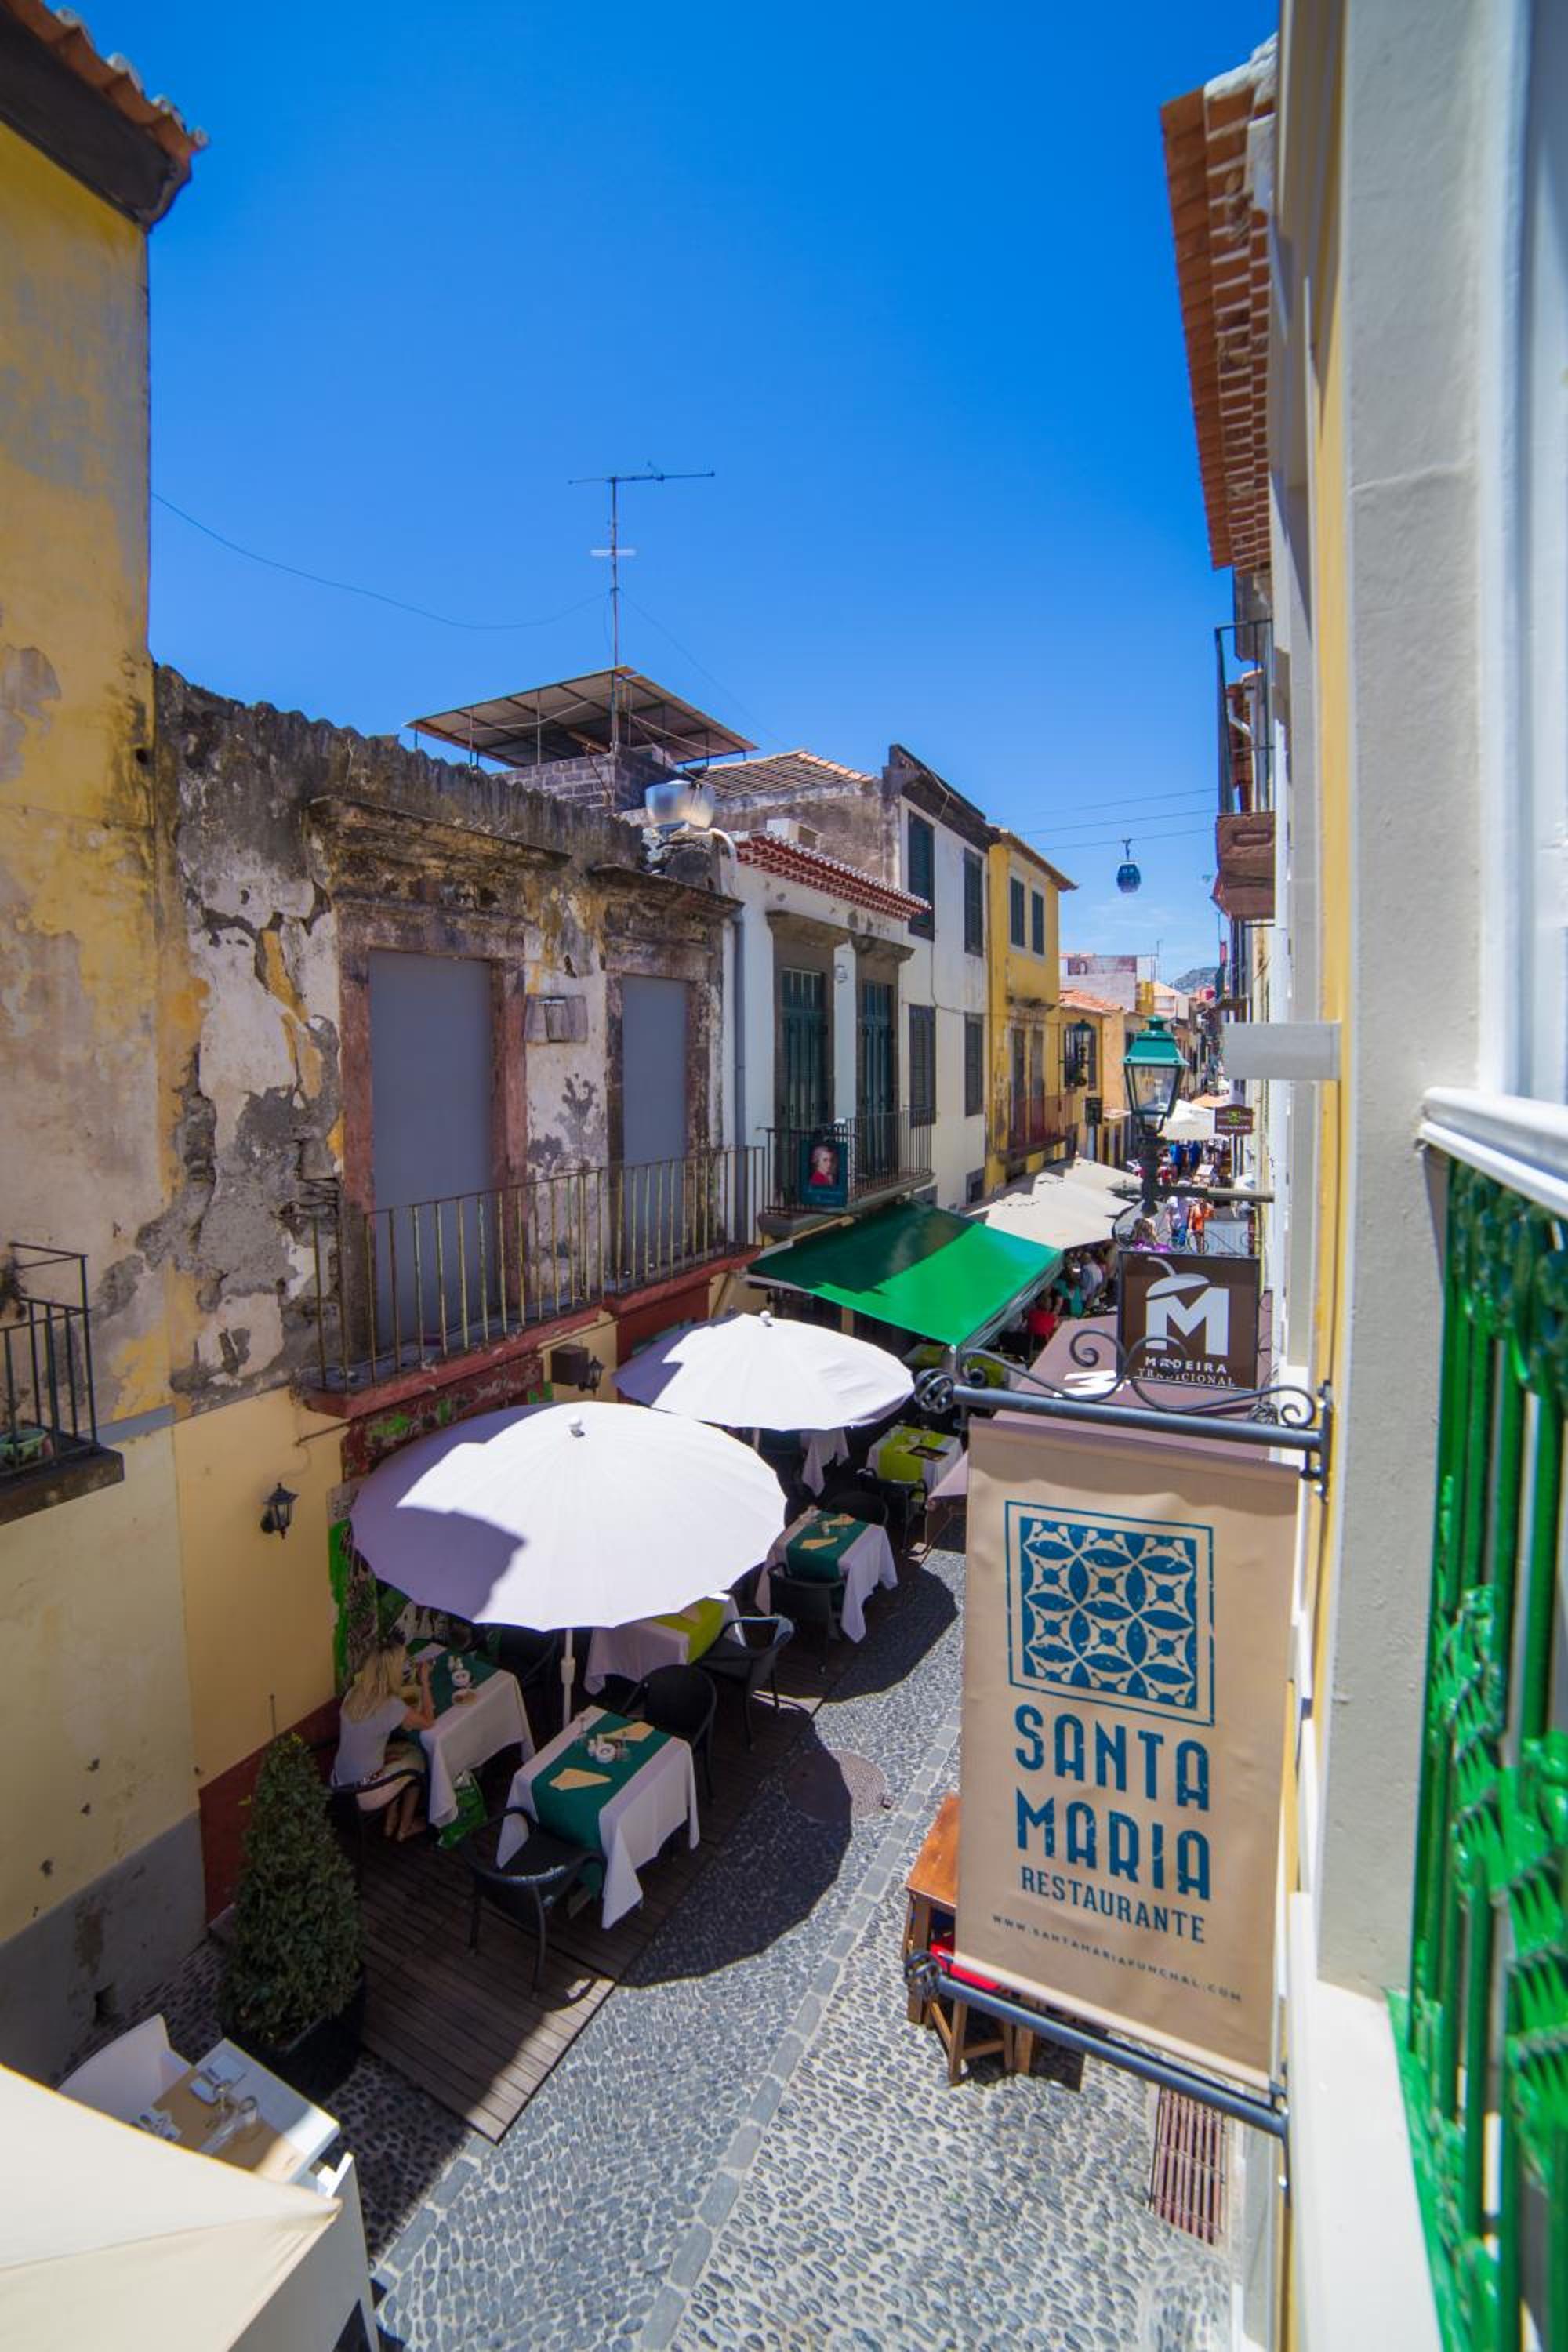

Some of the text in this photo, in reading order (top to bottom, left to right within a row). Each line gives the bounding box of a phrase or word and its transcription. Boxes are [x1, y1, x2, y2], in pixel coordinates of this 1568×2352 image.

[1138, 1367, 1236, 1387] TRAICIONAL
[1145, 1356, 1227, 1374] MADEIRA
[1014, 1704, 1210, 1812] SANTA
[1016, 1786, 1211, 1901] MARIA
[1021, 1865, 1206, 1944] RESTAURANTE
